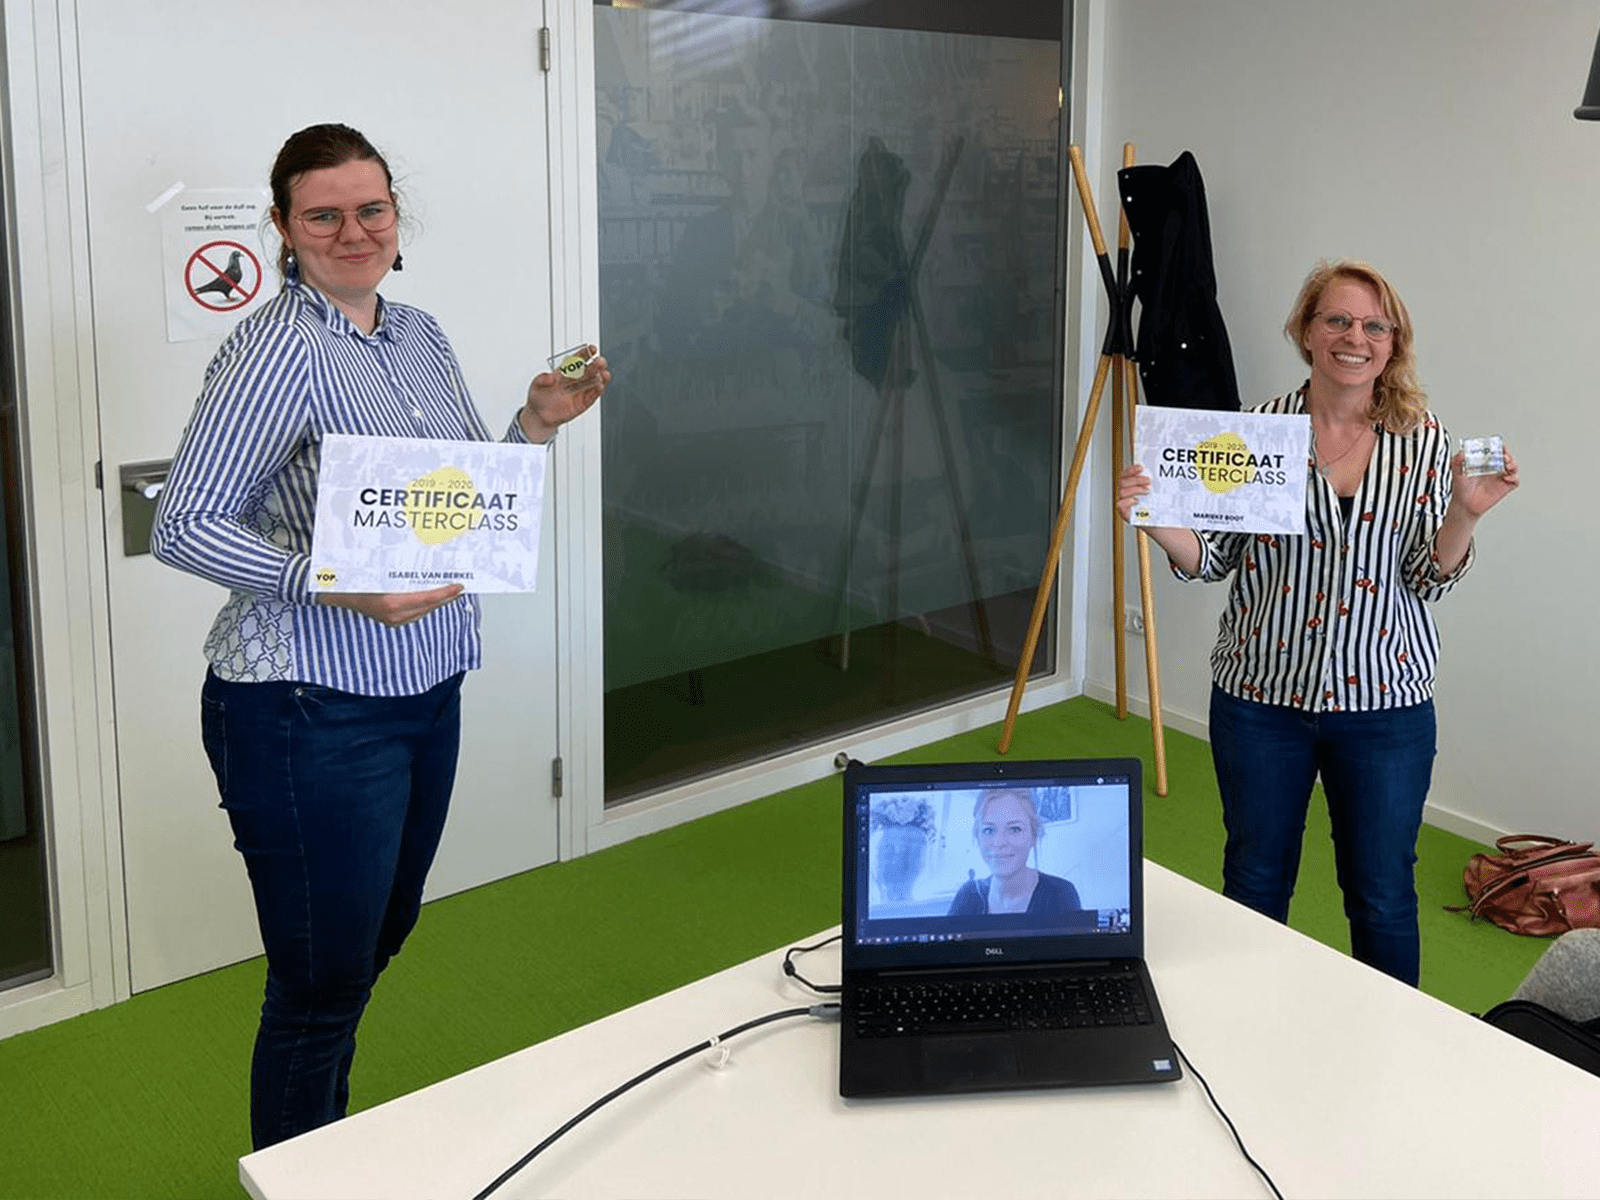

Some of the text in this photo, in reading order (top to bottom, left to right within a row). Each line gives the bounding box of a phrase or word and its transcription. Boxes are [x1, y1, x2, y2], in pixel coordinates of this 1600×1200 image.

[1162, 447, 1285, 469] CERTIFICAAT
[1158, 464, 1286, 485] MASTERCLASS
[412, 478, 435, 488] 2019
[448, 479, 474, 489] 2020
[360, 488, 517, 510] CERTIFICAAT
[354, 509, 518, 531] MASTERCLASS
[1193, 512, 1224, 520] MARIEKE
[388, 571, 474, 579] ISABEL VAN BERKEL
[985, 947, 1004, 955] DELL
